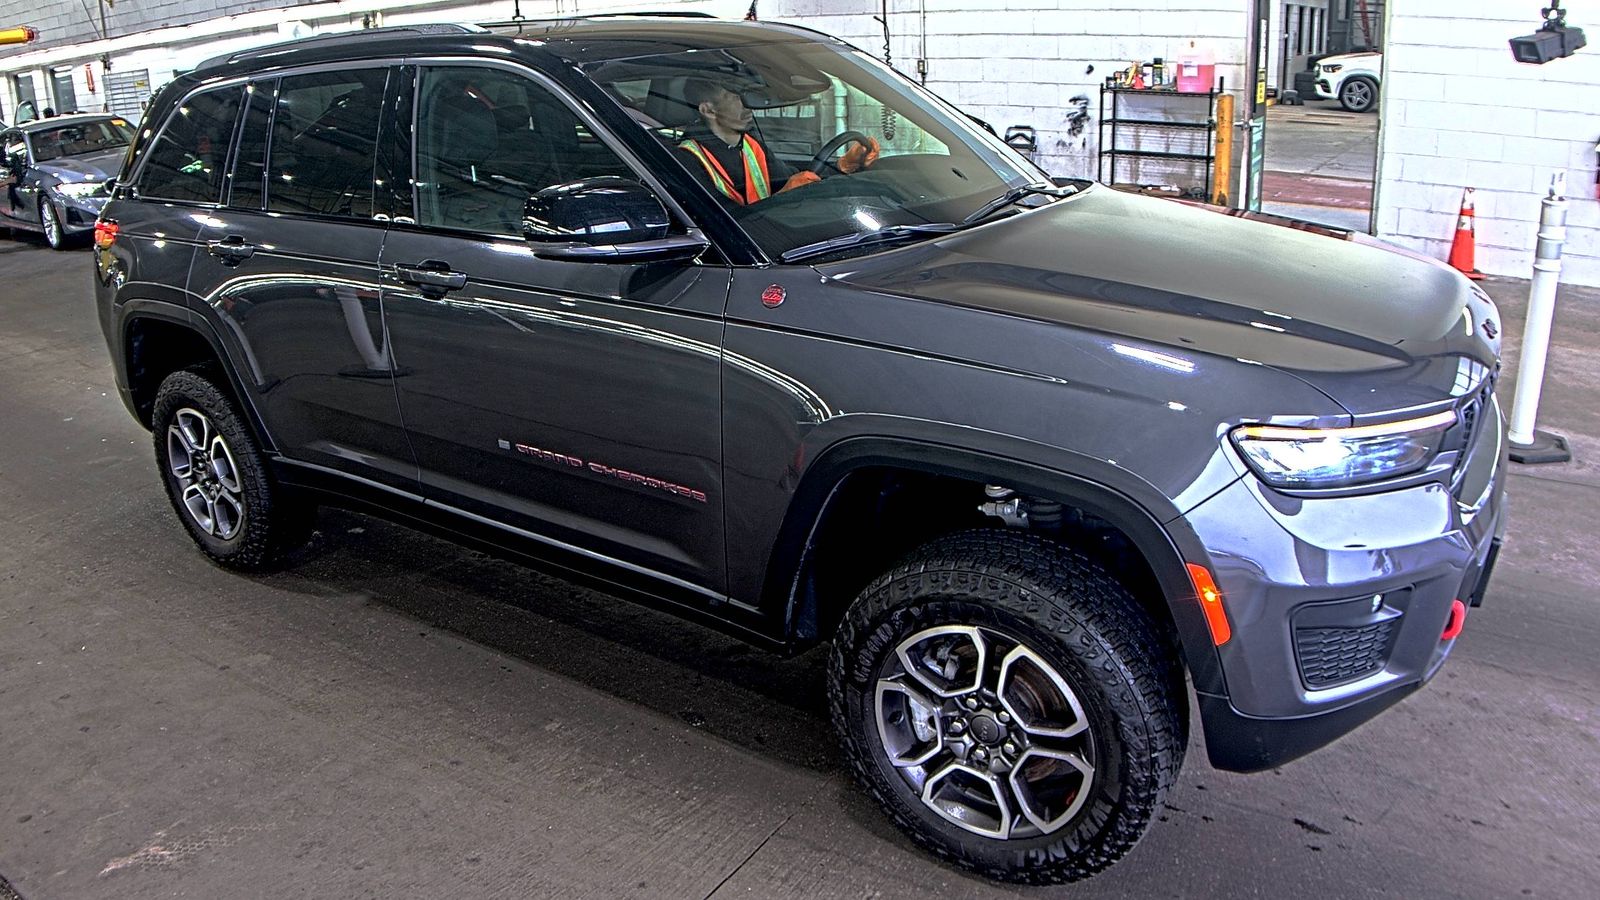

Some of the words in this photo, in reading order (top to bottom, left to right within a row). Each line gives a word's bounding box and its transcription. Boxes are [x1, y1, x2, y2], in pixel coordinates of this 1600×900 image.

[515, 442, 583, 467] GRAND
[588, 461, 706, 503] CHEROKEE
[1010, 798, 1113, 867] WRANGL
